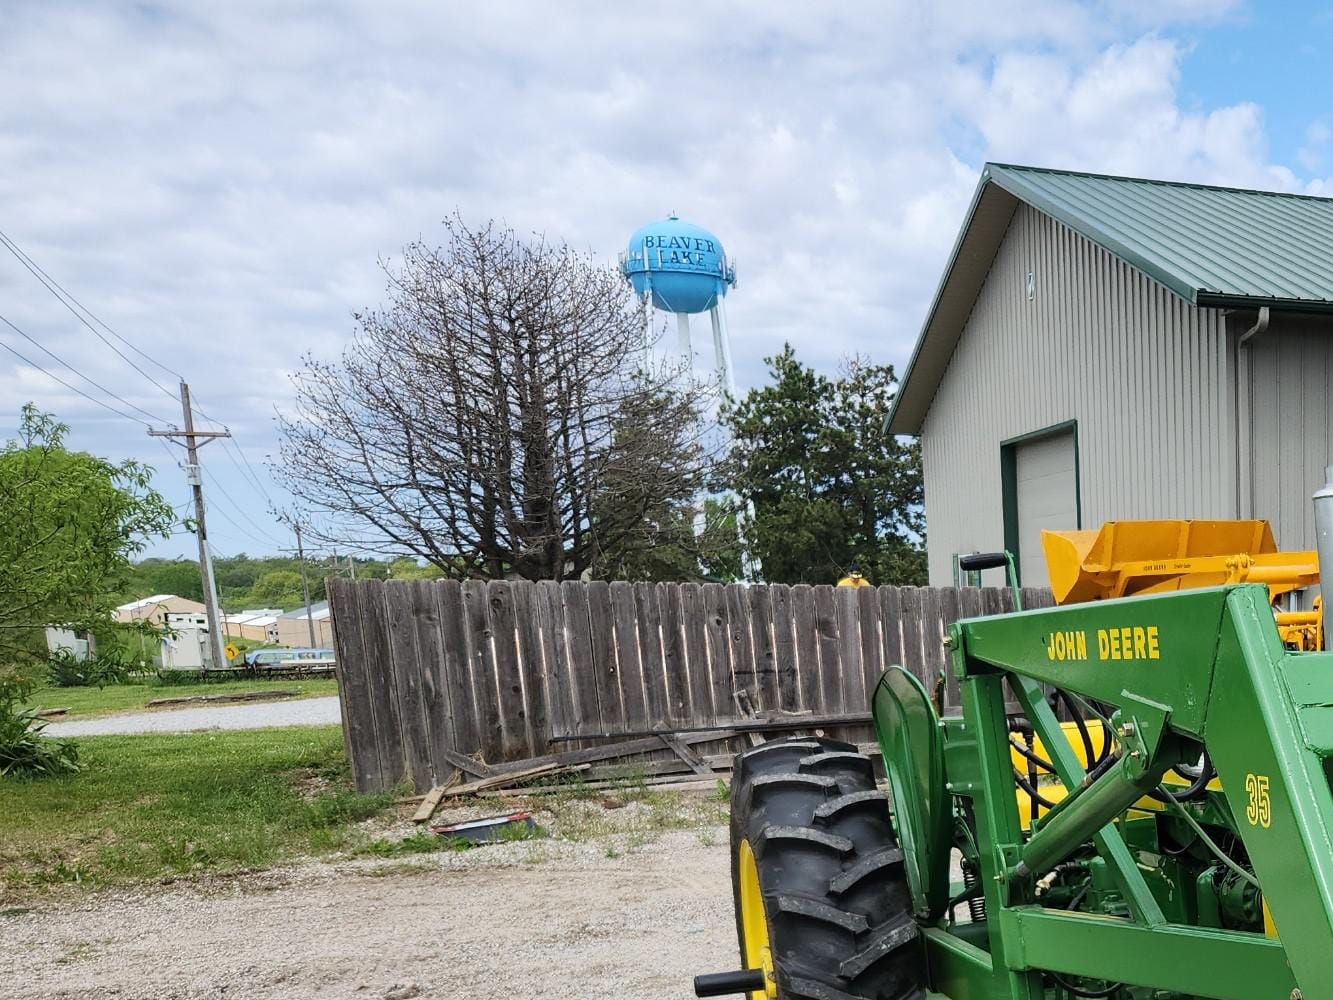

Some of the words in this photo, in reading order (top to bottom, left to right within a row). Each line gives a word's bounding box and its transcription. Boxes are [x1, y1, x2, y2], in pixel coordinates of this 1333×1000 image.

[645, 235, 716, 254] BEAVER
[660, 249, 707, 267] LAKE
[1047, 630, 1088, 660] JOHN
[1098, 626, 1160, 660] DEERE
[1245, 773, 1271, 828] 35
